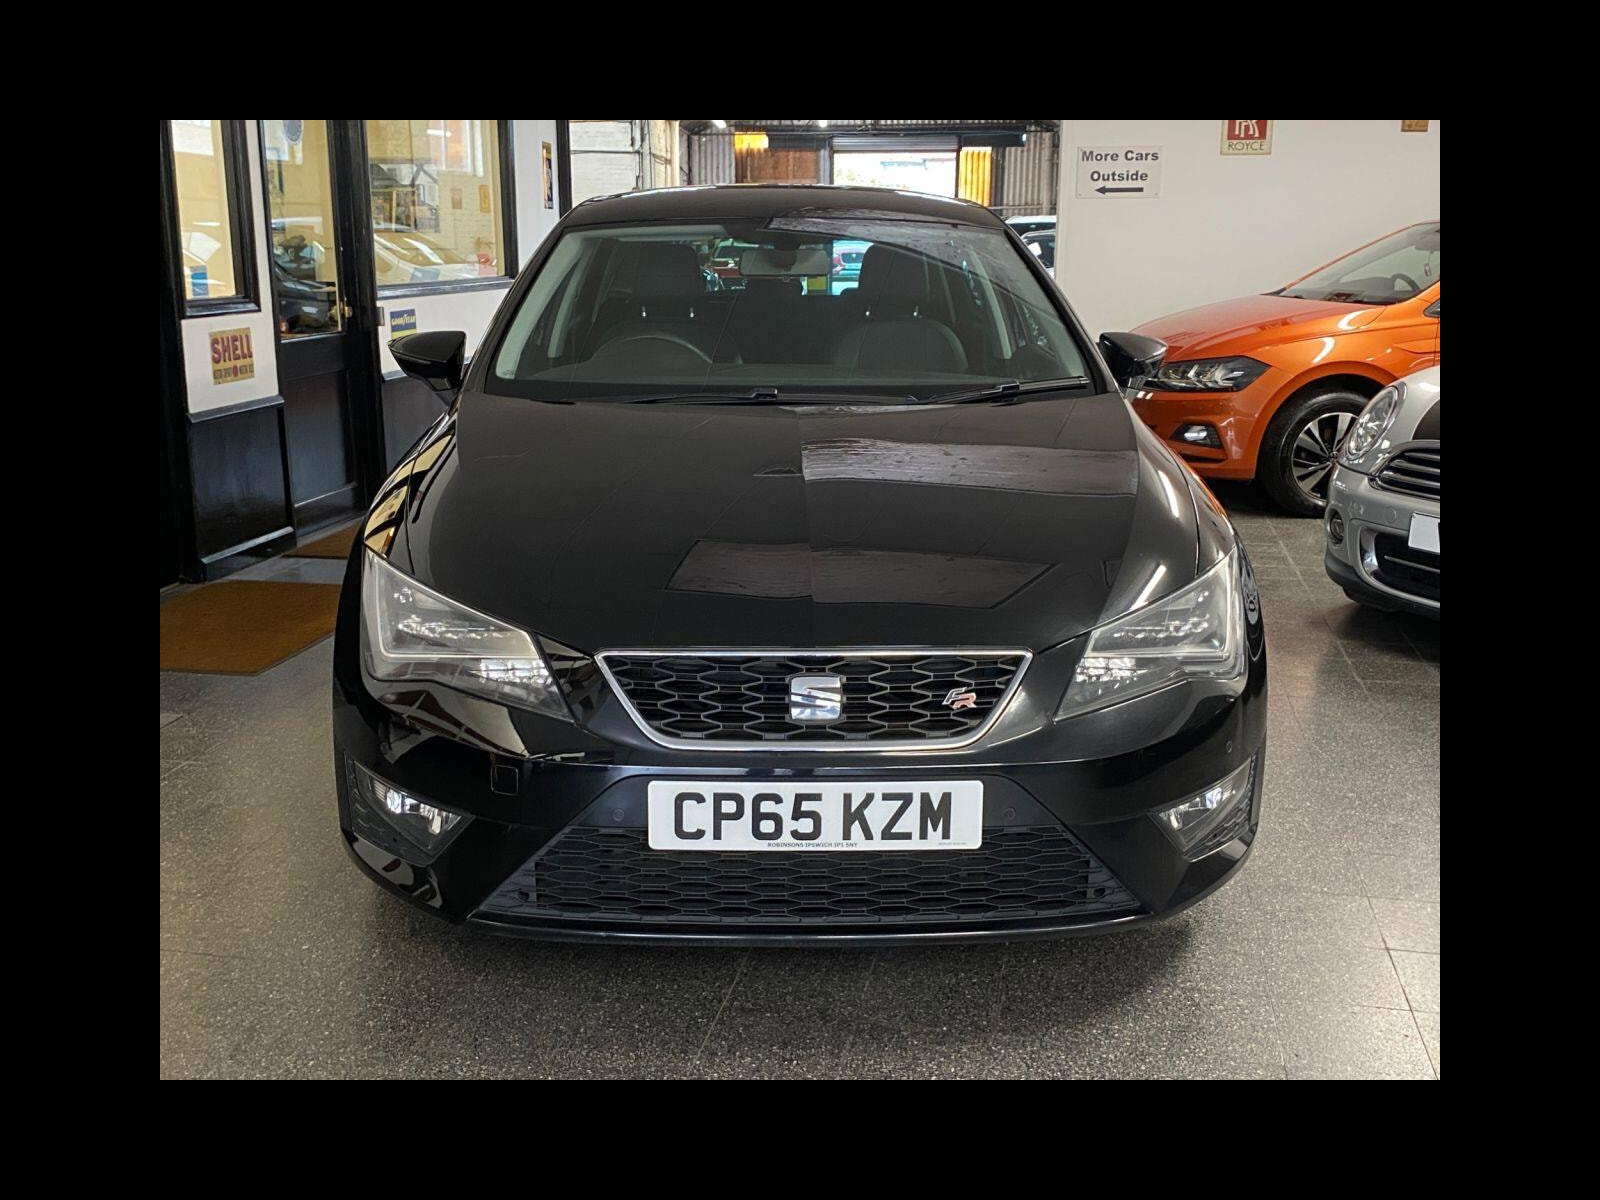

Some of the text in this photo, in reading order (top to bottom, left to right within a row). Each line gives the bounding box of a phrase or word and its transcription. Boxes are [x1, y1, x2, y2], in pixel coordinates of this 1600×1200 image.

[1227, 141, 1265, 151] ROYCE
[1081, 150, 1159, 162] More Cars
[1090, 170, 1149, 182] Outside
[211, 334, 253, 364] SHELL
[674, 791, 952, 840] CP65 KZM
